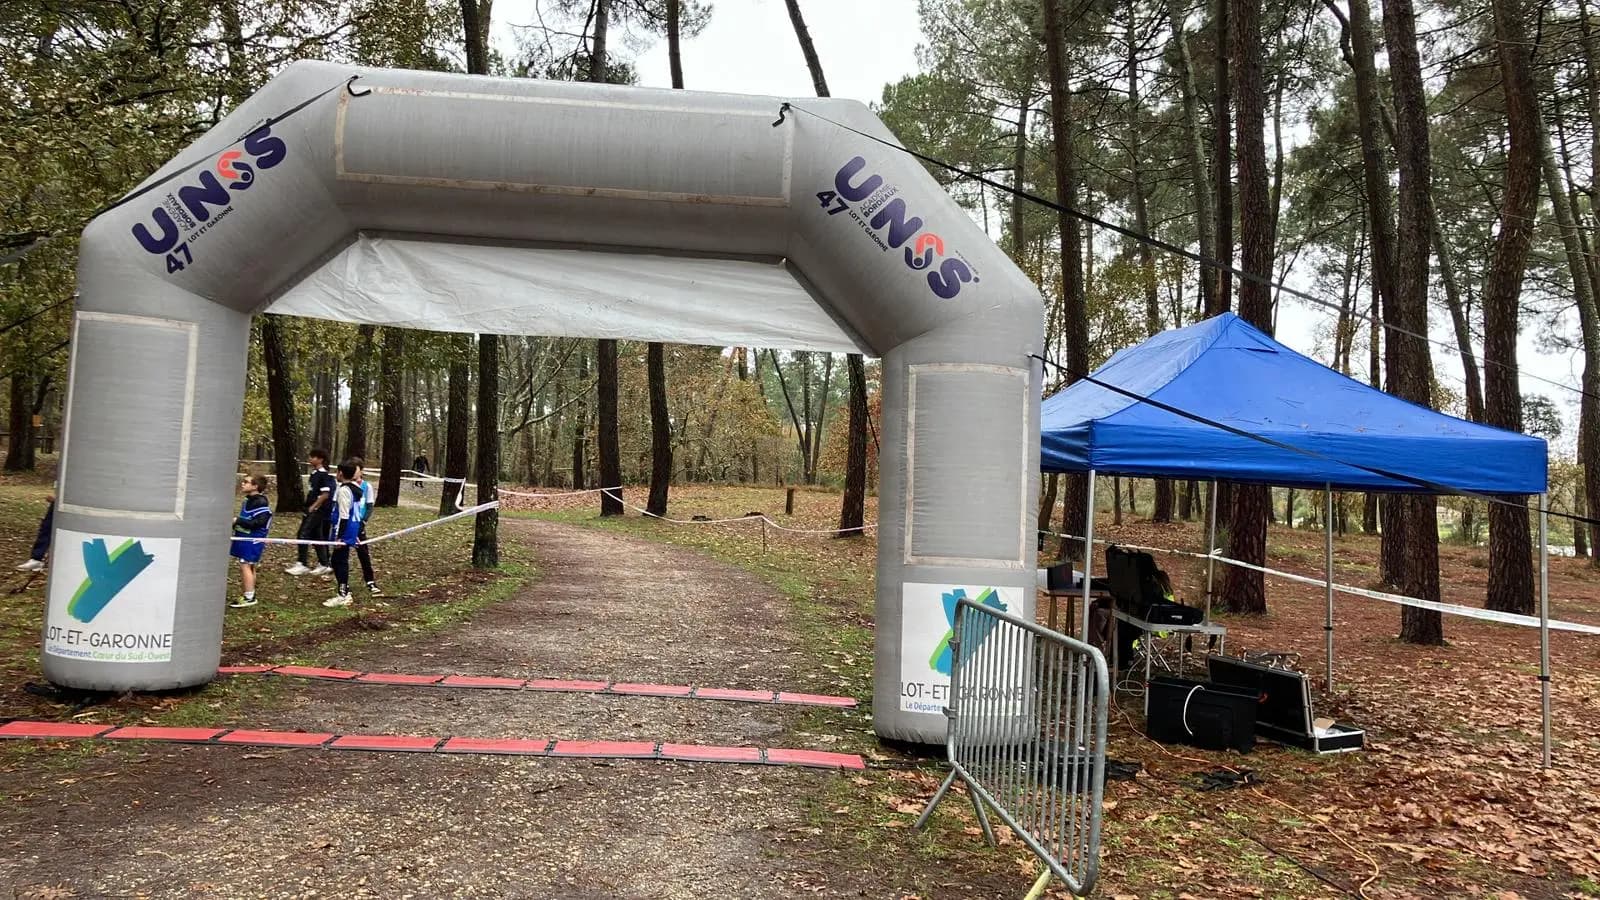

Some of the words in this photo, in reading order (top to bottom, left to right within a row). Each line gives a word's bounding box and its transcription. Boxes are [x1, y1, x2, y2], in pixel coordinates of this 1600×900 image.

[166, 193, 196, 228] BORDEAUX
[816, 191, 849, 215] 47
[862, 186, 899, 218] BORDEAUX
[188, 231, 201, 243] LOT
[200, 226, 207, 234] ET
[206, 206, 234, 228] GARONNE
[849, 210, 860, 221] LOT
[858, 220, 866, 228] ET
[864, 227, 888, 252] GARONNE
[166, 242, 193, 274] 47
[905, 700, 913, 709] Le
